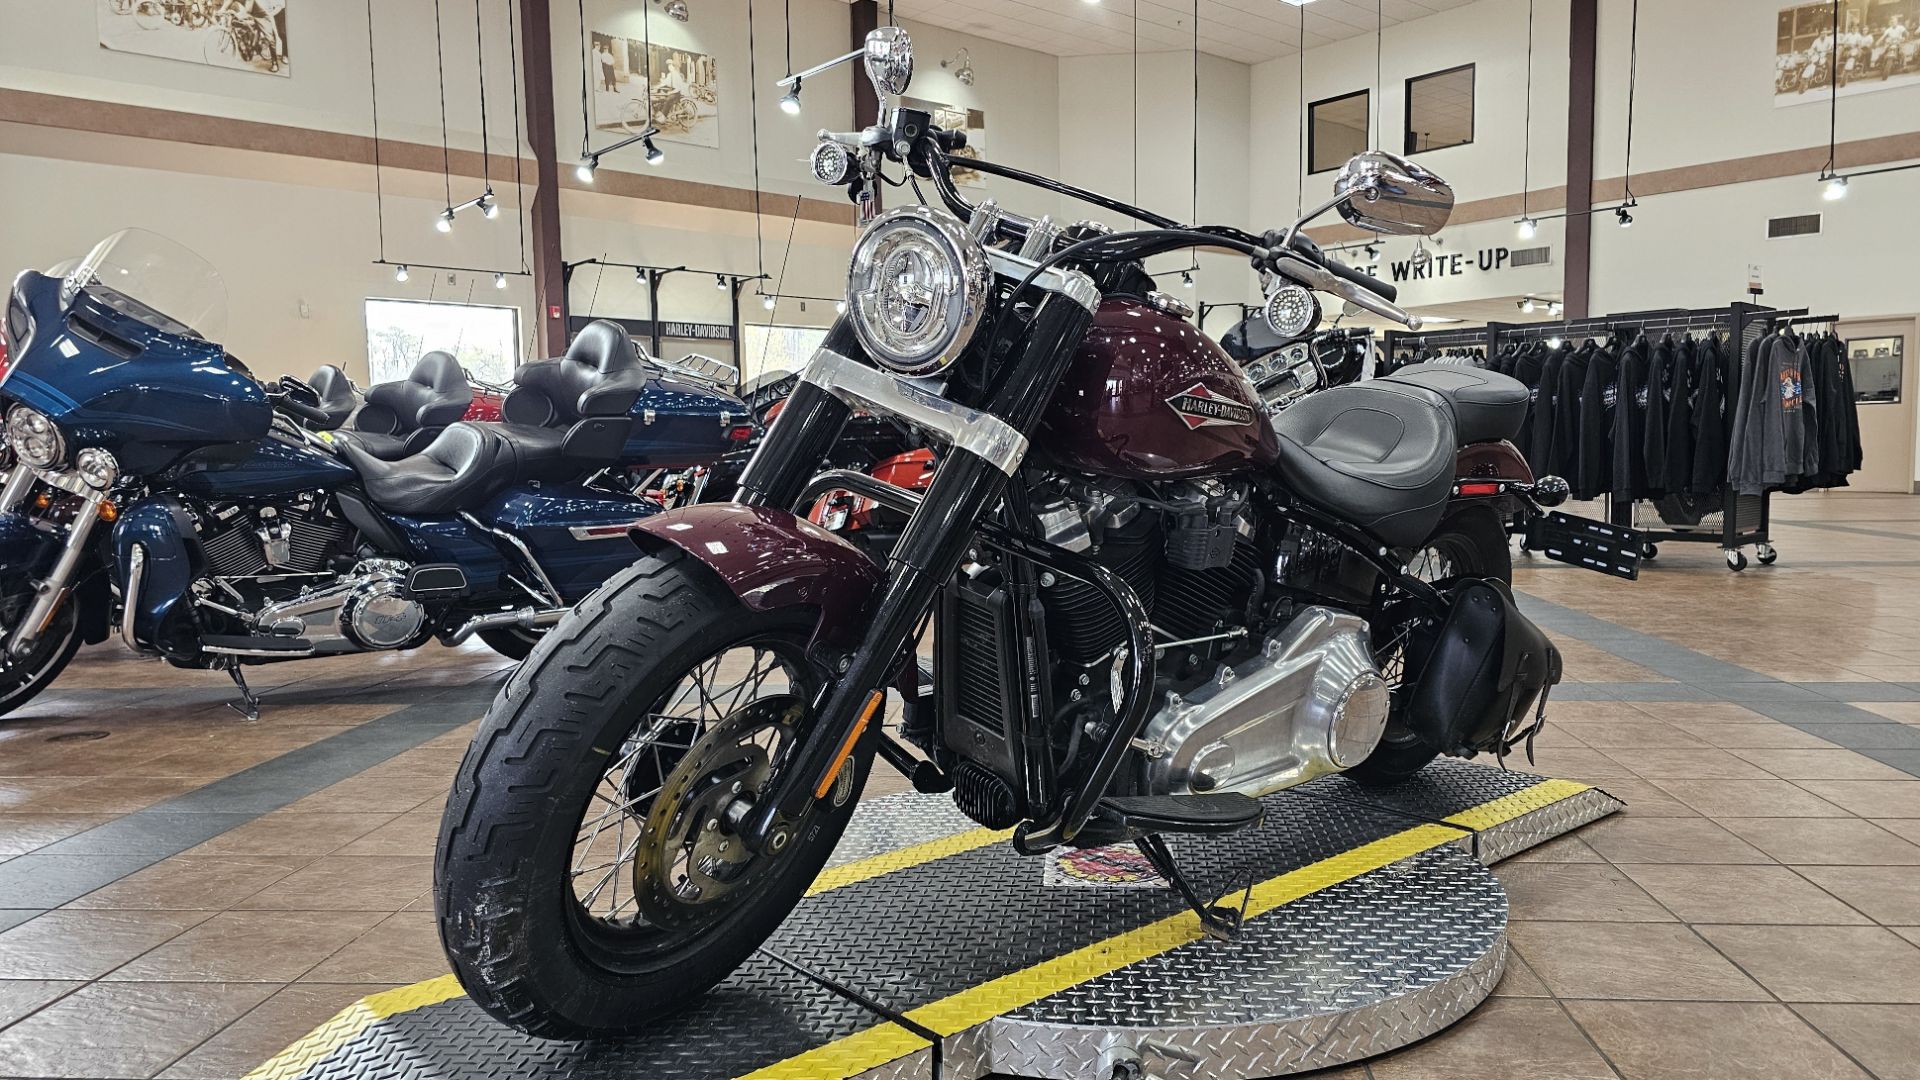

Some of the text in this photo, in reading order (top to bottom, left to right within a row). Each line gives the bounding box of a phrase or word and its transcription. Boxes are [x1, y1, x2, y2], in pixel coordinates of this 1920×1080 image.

[1391, 247, 1508, 282] WRITE-UP
[665, 323, 730, 338] HARLEY-DAVIDSON
[1181, 397, 1251, 421] HARLEY-DAVIDSON
